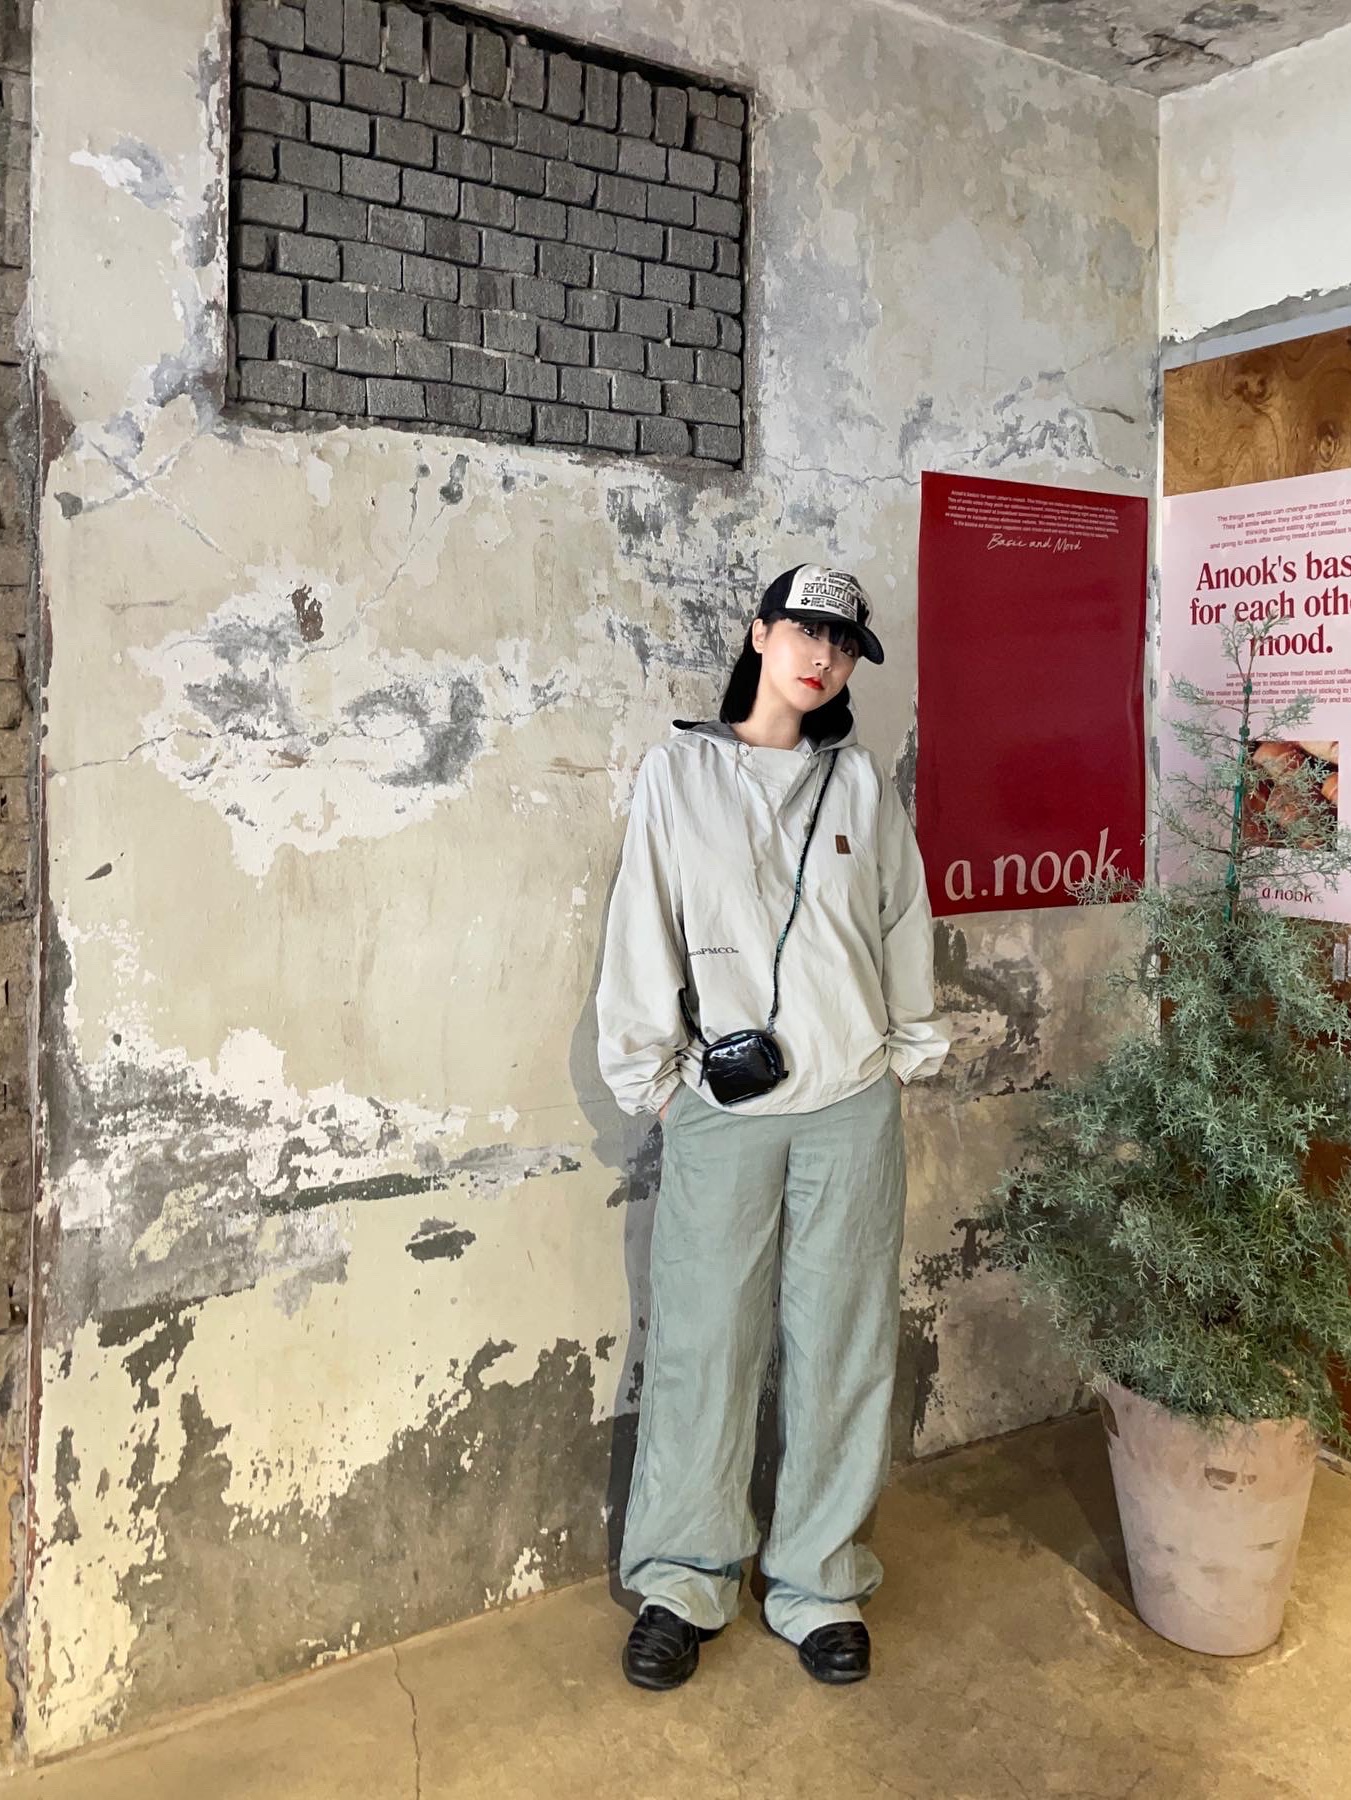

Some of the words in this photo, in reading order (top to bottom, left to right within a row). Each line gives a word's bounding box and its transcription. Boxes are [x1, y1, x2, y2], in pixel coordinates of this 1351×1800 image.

[987, 532, 1027, 550] Basic
[1028, 537, 1052, 549] and
[1052, 536, 1082, 553] Mood
[1196, 555, 1297, 591] Anook's
[1306, 550, 1351, 581] bas
[1190, 597, 1227, 625] for
[1234, 590, 1295, 622] each
[1304, 585, 1351, 618] oth
[944, 826, 1123, 901] a.nook
